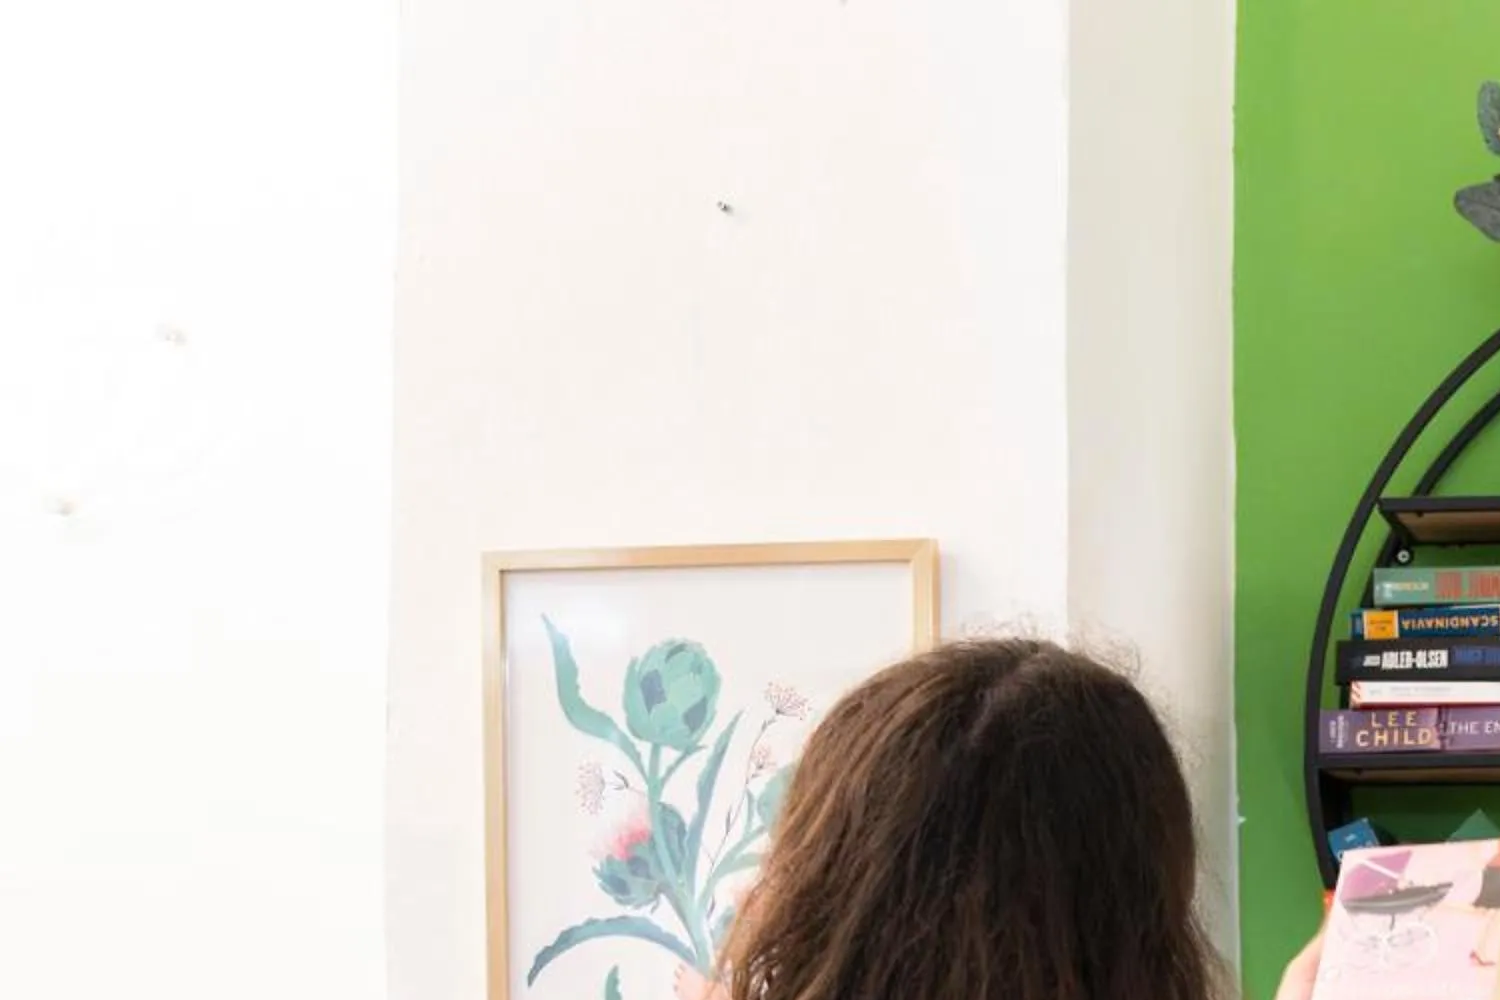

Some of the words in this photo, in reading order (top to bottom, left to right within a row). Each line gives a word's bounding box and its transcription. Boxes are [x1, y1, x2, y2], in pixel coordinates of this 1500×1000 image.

[1401, 614, 1500, 631] SCANDINAVIA
[1381, 650, 1449, 669] ADLER-OLSEN
[1370, 710, 1418, 727] LEE
[1448, 719, 1481, 735] THE
[1355, 729, 1433, 747] CHILD
